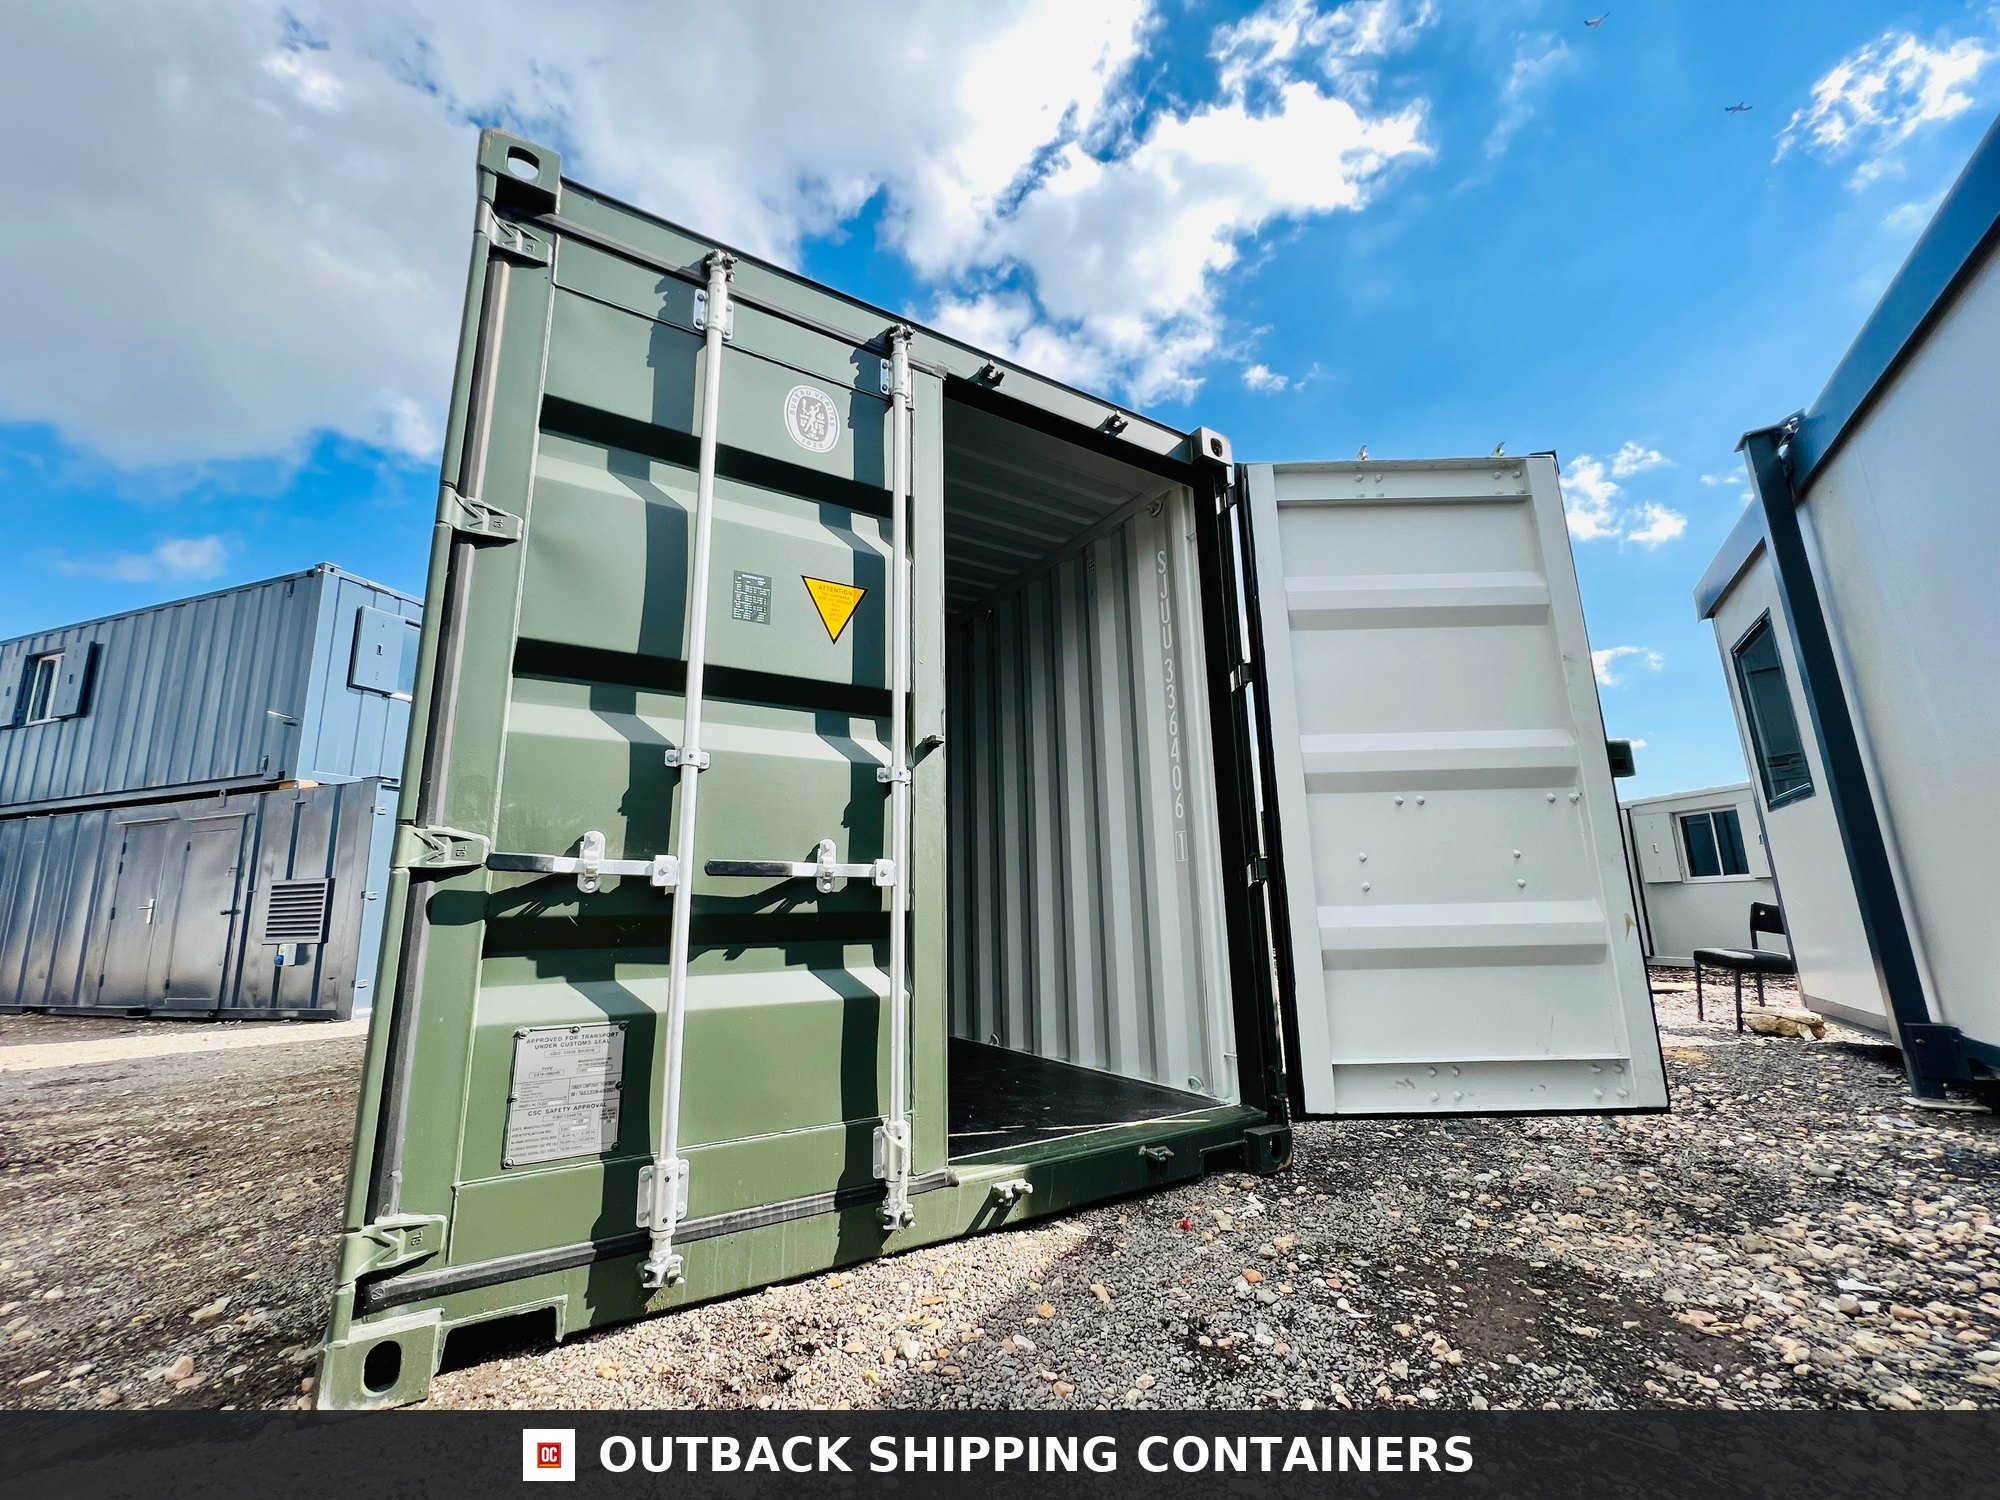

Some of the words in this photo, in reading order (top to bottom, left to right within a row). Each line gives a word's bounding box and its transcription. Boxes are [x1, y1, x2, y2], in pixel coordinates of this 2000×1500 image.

[790, 390, 811, 415] BUREAU
[814, 391, 835, 427] VERITAS
[818, 584, 853, 596] ATTENTION
[1157, 550, 1173, 649] SJUU
[1164, 658, 1184, 819] 336406
[526, 1036, 562, 1044] APPROVED
[582, 1031, 620, 1040] TRANSPORT
[545, 1106, 570, 1115] SAFETY
[573, 1102, 607, 1111] APPROVAL
